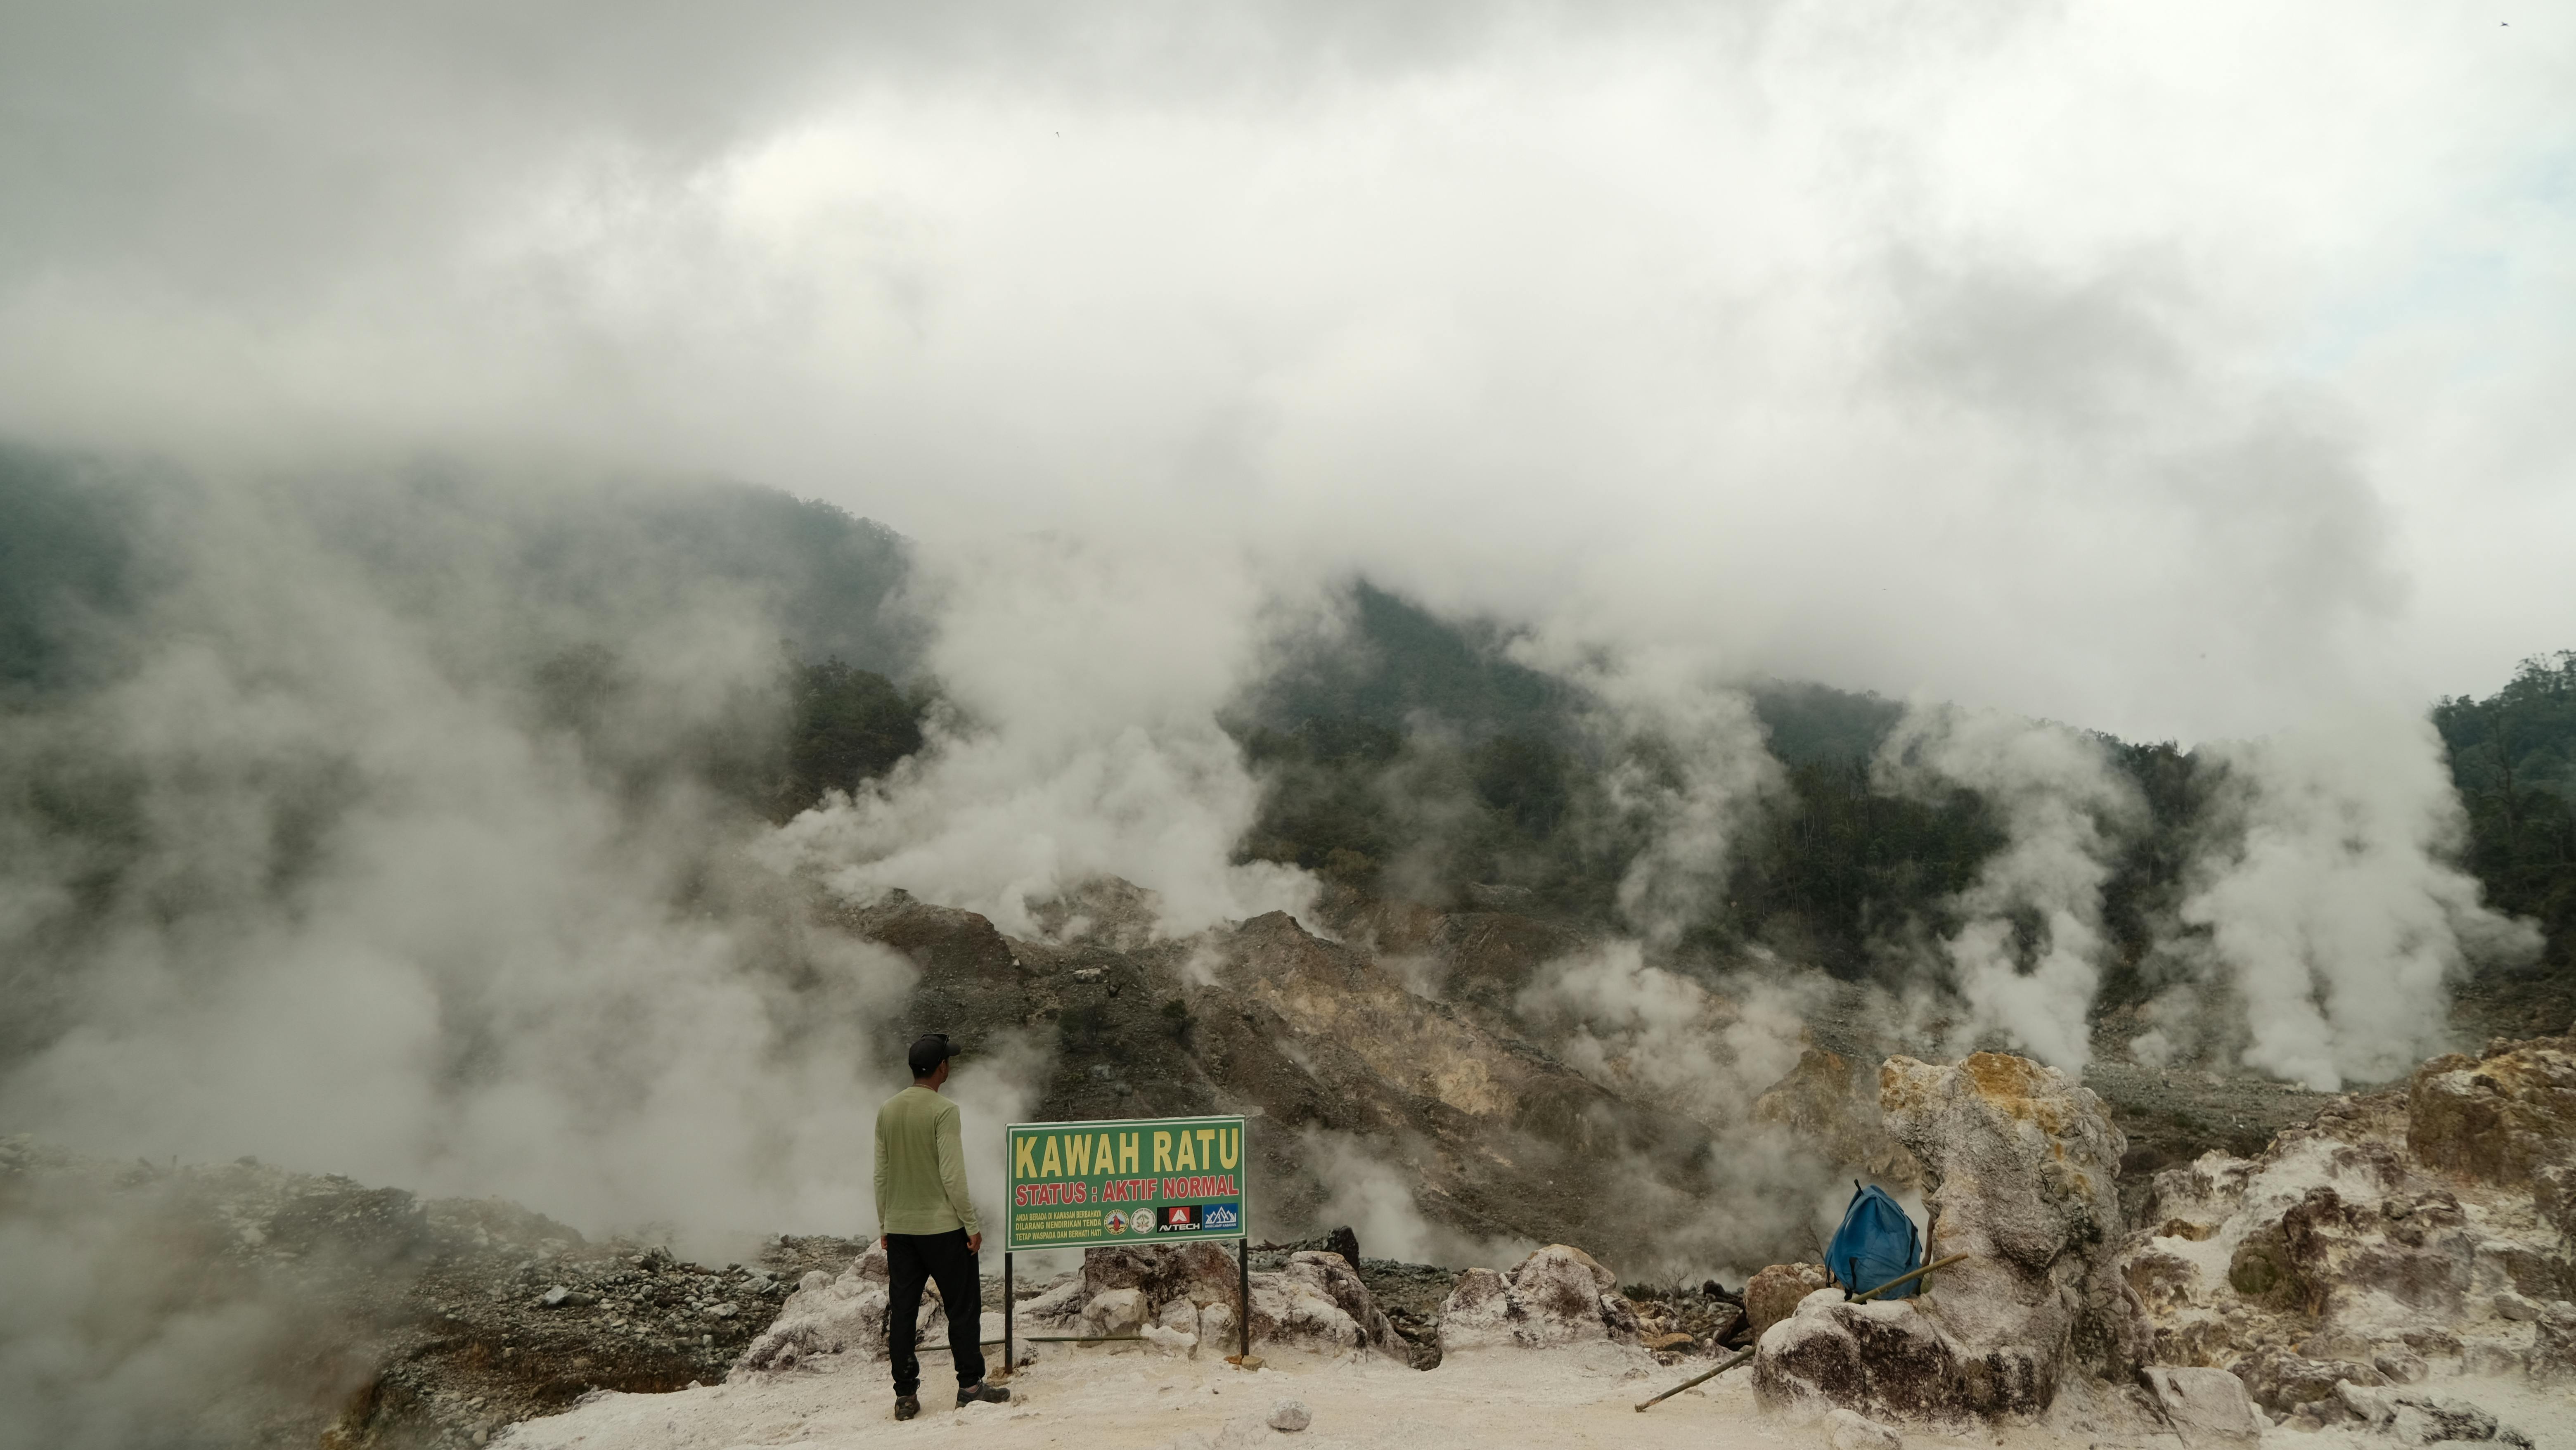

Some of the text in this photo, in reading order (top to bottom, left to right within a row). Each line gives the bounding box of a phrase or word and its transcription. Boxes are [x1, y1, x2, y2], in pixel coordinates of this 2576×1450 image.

[1016, 1128, 1238, 1179] KAWAH RATU
[1015, 1174, 1239, 1207] STATUS : AKTIF NORMAL
[1054, 1211, 1075, 1219] KAWASAN
[1016, 1222, 1044, 1231] DILARANG
[1046, 1220, 1081, 1229] MENDIRIKAN
[1159, 1223, 1200, 1232] AVTECH
[1032, 1231, 1056, 1240] WASPADA
[1068, 1230, 1089, 1238] BERHATI
